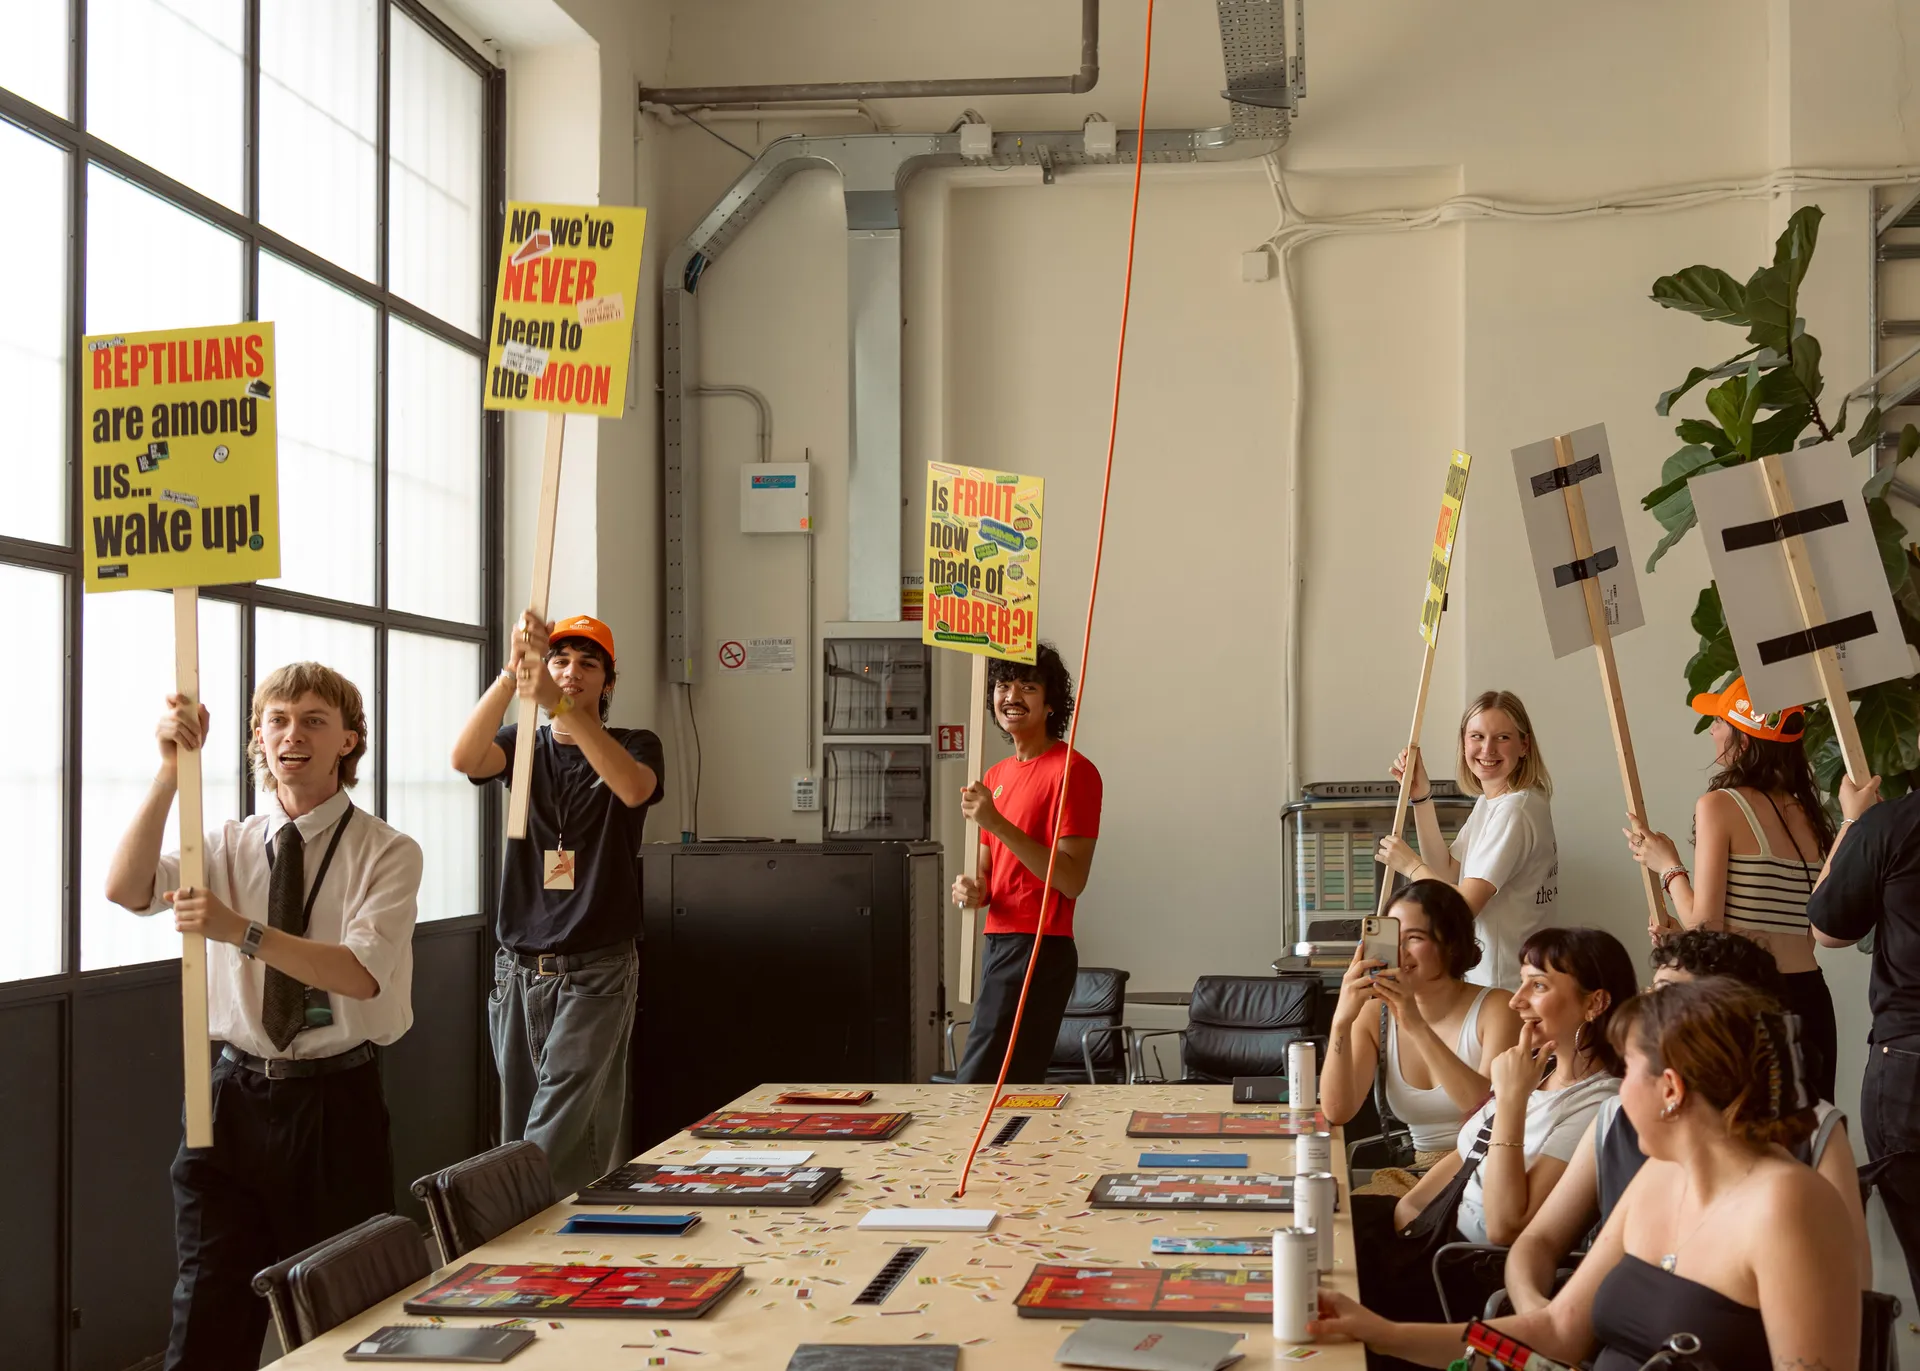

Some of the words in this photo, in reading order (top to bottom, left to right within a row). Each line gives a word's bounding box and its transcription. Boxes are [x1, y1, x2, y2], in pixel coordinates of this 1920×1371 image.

[510, 209, 541, 243] NO
[550, 212, 614, 249] we've
[502, 256, 597, 305] NEVER
[496, 313, 555, 350] been
[559, 318, 583, 352] to
[93, 334, 264, 390] REPTILIANS
[491, 366, 529, 400] the
[533, 362, 611, 406] MOON
[93, 405, 143, 443] are
[151, 396, 257, 438] among
[93, 463, 151, 500] us...
[931, 480, 948, 513] Is
[953, 477, 1016, 523] FRUIT
[93, 502, 192, 559] wake
[202, 494, 261, 554] up!
[930, 521, 969, 553] now
[929, 557, 981, 590] made
[985, 564, 1005, 595] of
[928, 593, 1034, 649] RUBBER?!
[1536, 885, 1553, 905] the
